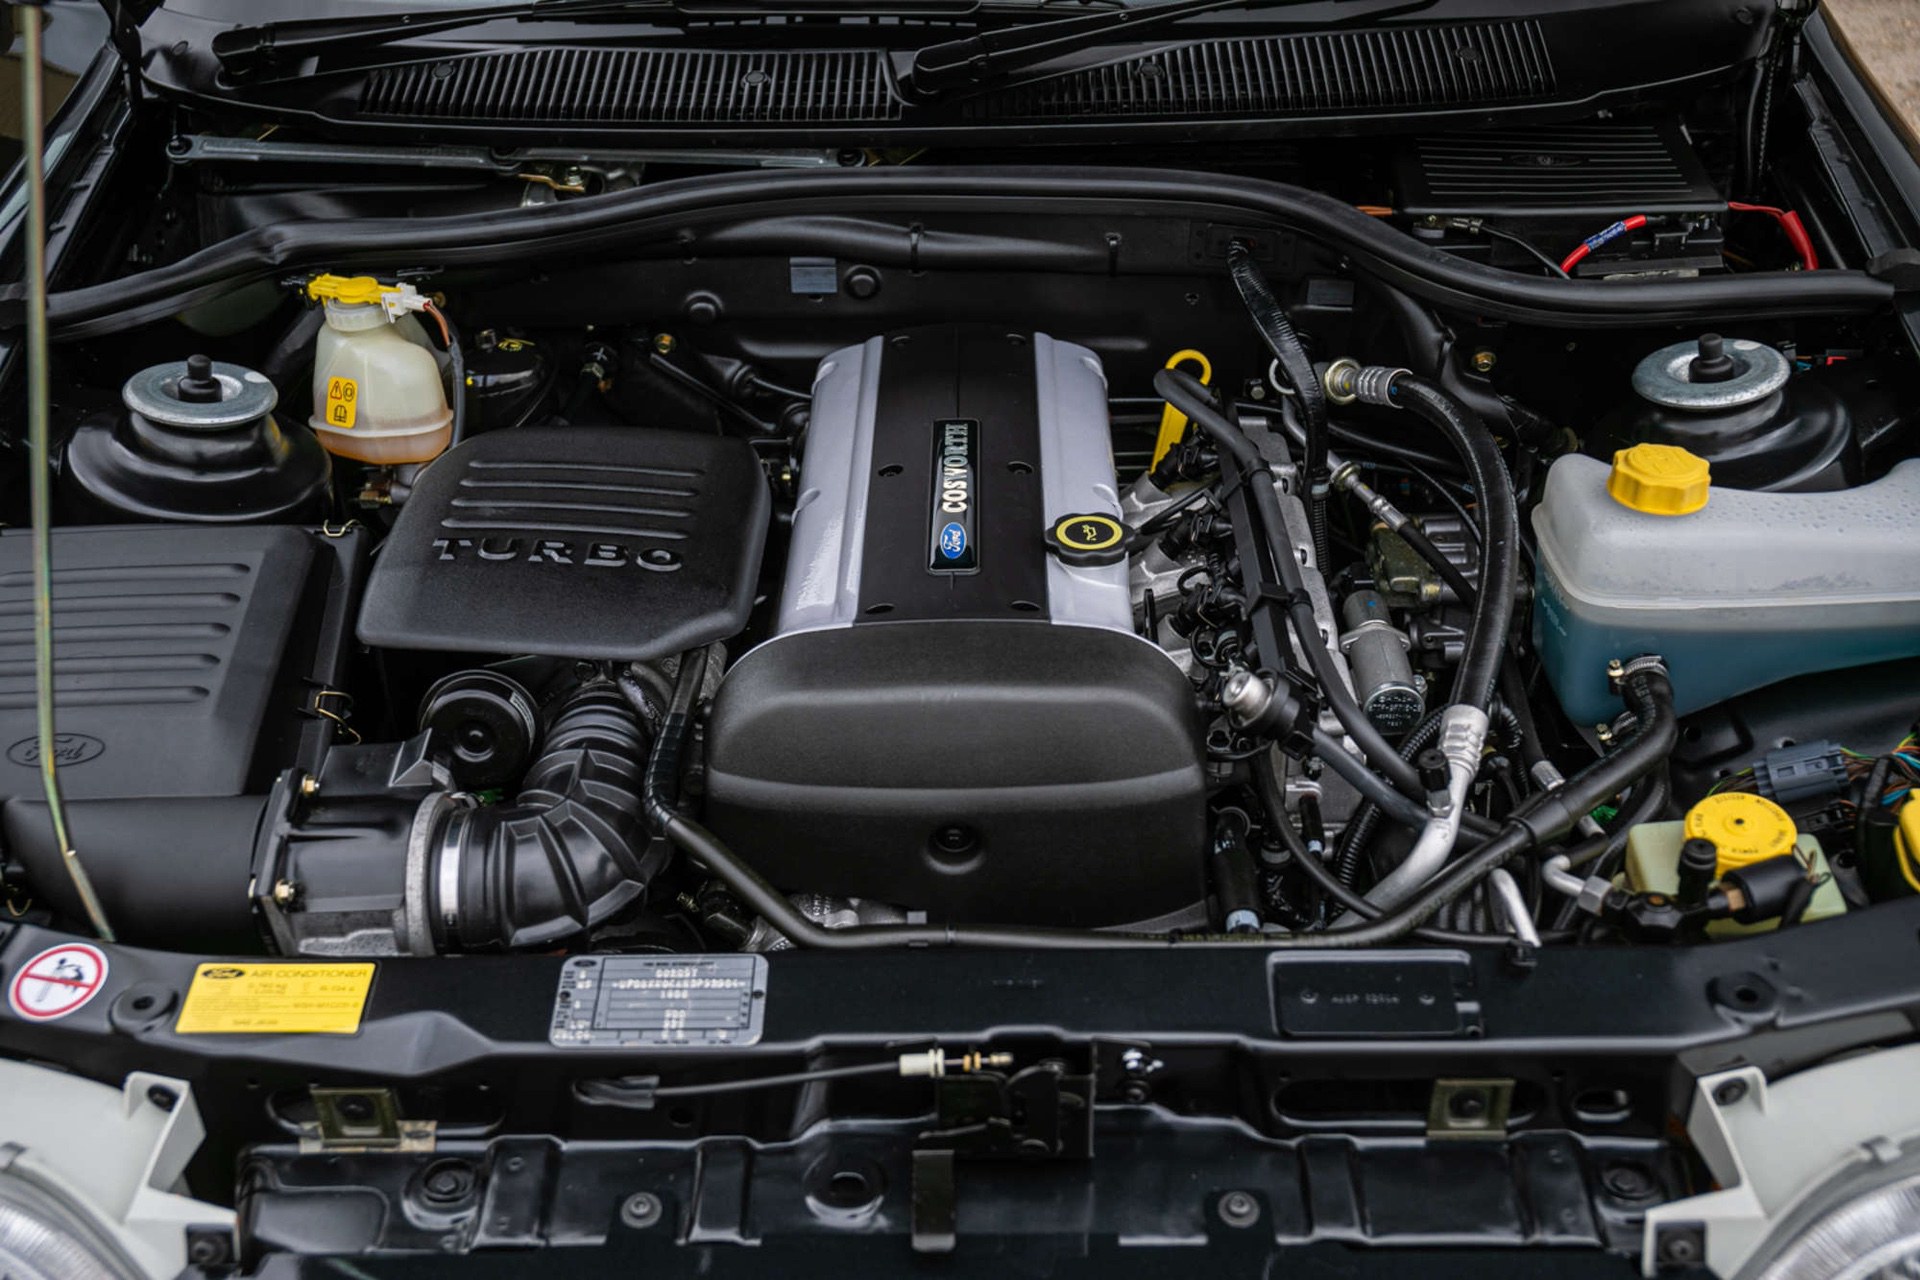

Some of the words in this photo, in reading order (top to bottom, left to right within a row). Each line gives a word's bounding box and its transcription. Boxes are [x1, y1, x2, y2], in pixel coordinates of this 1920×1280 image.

[941, 423, 968, 514] COSWORTH
[432, 537, 683, 572] TURBO
[251, 969, 273, 978] AIR
[275, 969, 368, 978] CONDITIONER
